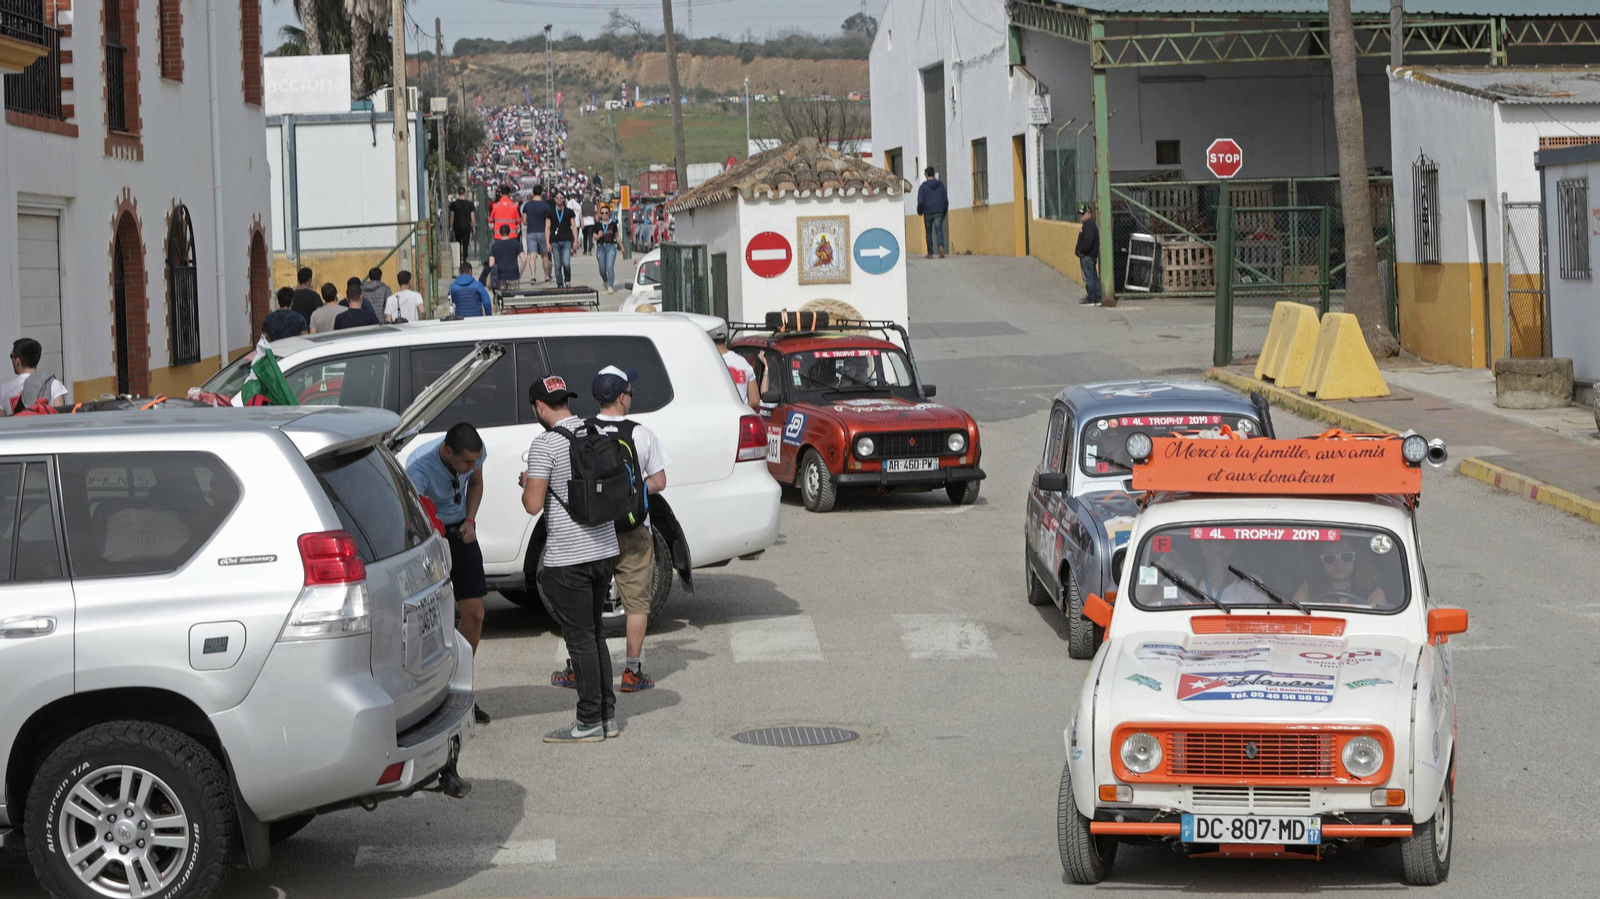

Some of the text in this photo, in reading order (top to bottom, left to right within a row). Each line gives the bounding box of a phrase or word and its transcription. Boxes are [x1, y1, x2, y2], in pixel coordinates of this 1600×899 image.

[1210, 153, 1240, 163] STOP
[1132, 416, 1208, 425] 4L TROPHY 2019
[1164, 440, 1386, 463] Merci à la famille, aux amis
[1207, 468, 1336, 483] et aux donateurs
[1209, 528, 1320, 540] 4L TROPHY 2019
[1158, 538, 1168, 551] F
[1299, 649, 1381, 660] Orpi
[70, 761, 91, 778] T/A
[46, 778, 69, 854] All-Terrain
[1185, 818, 1319, 841] F DC-807-MD 17
